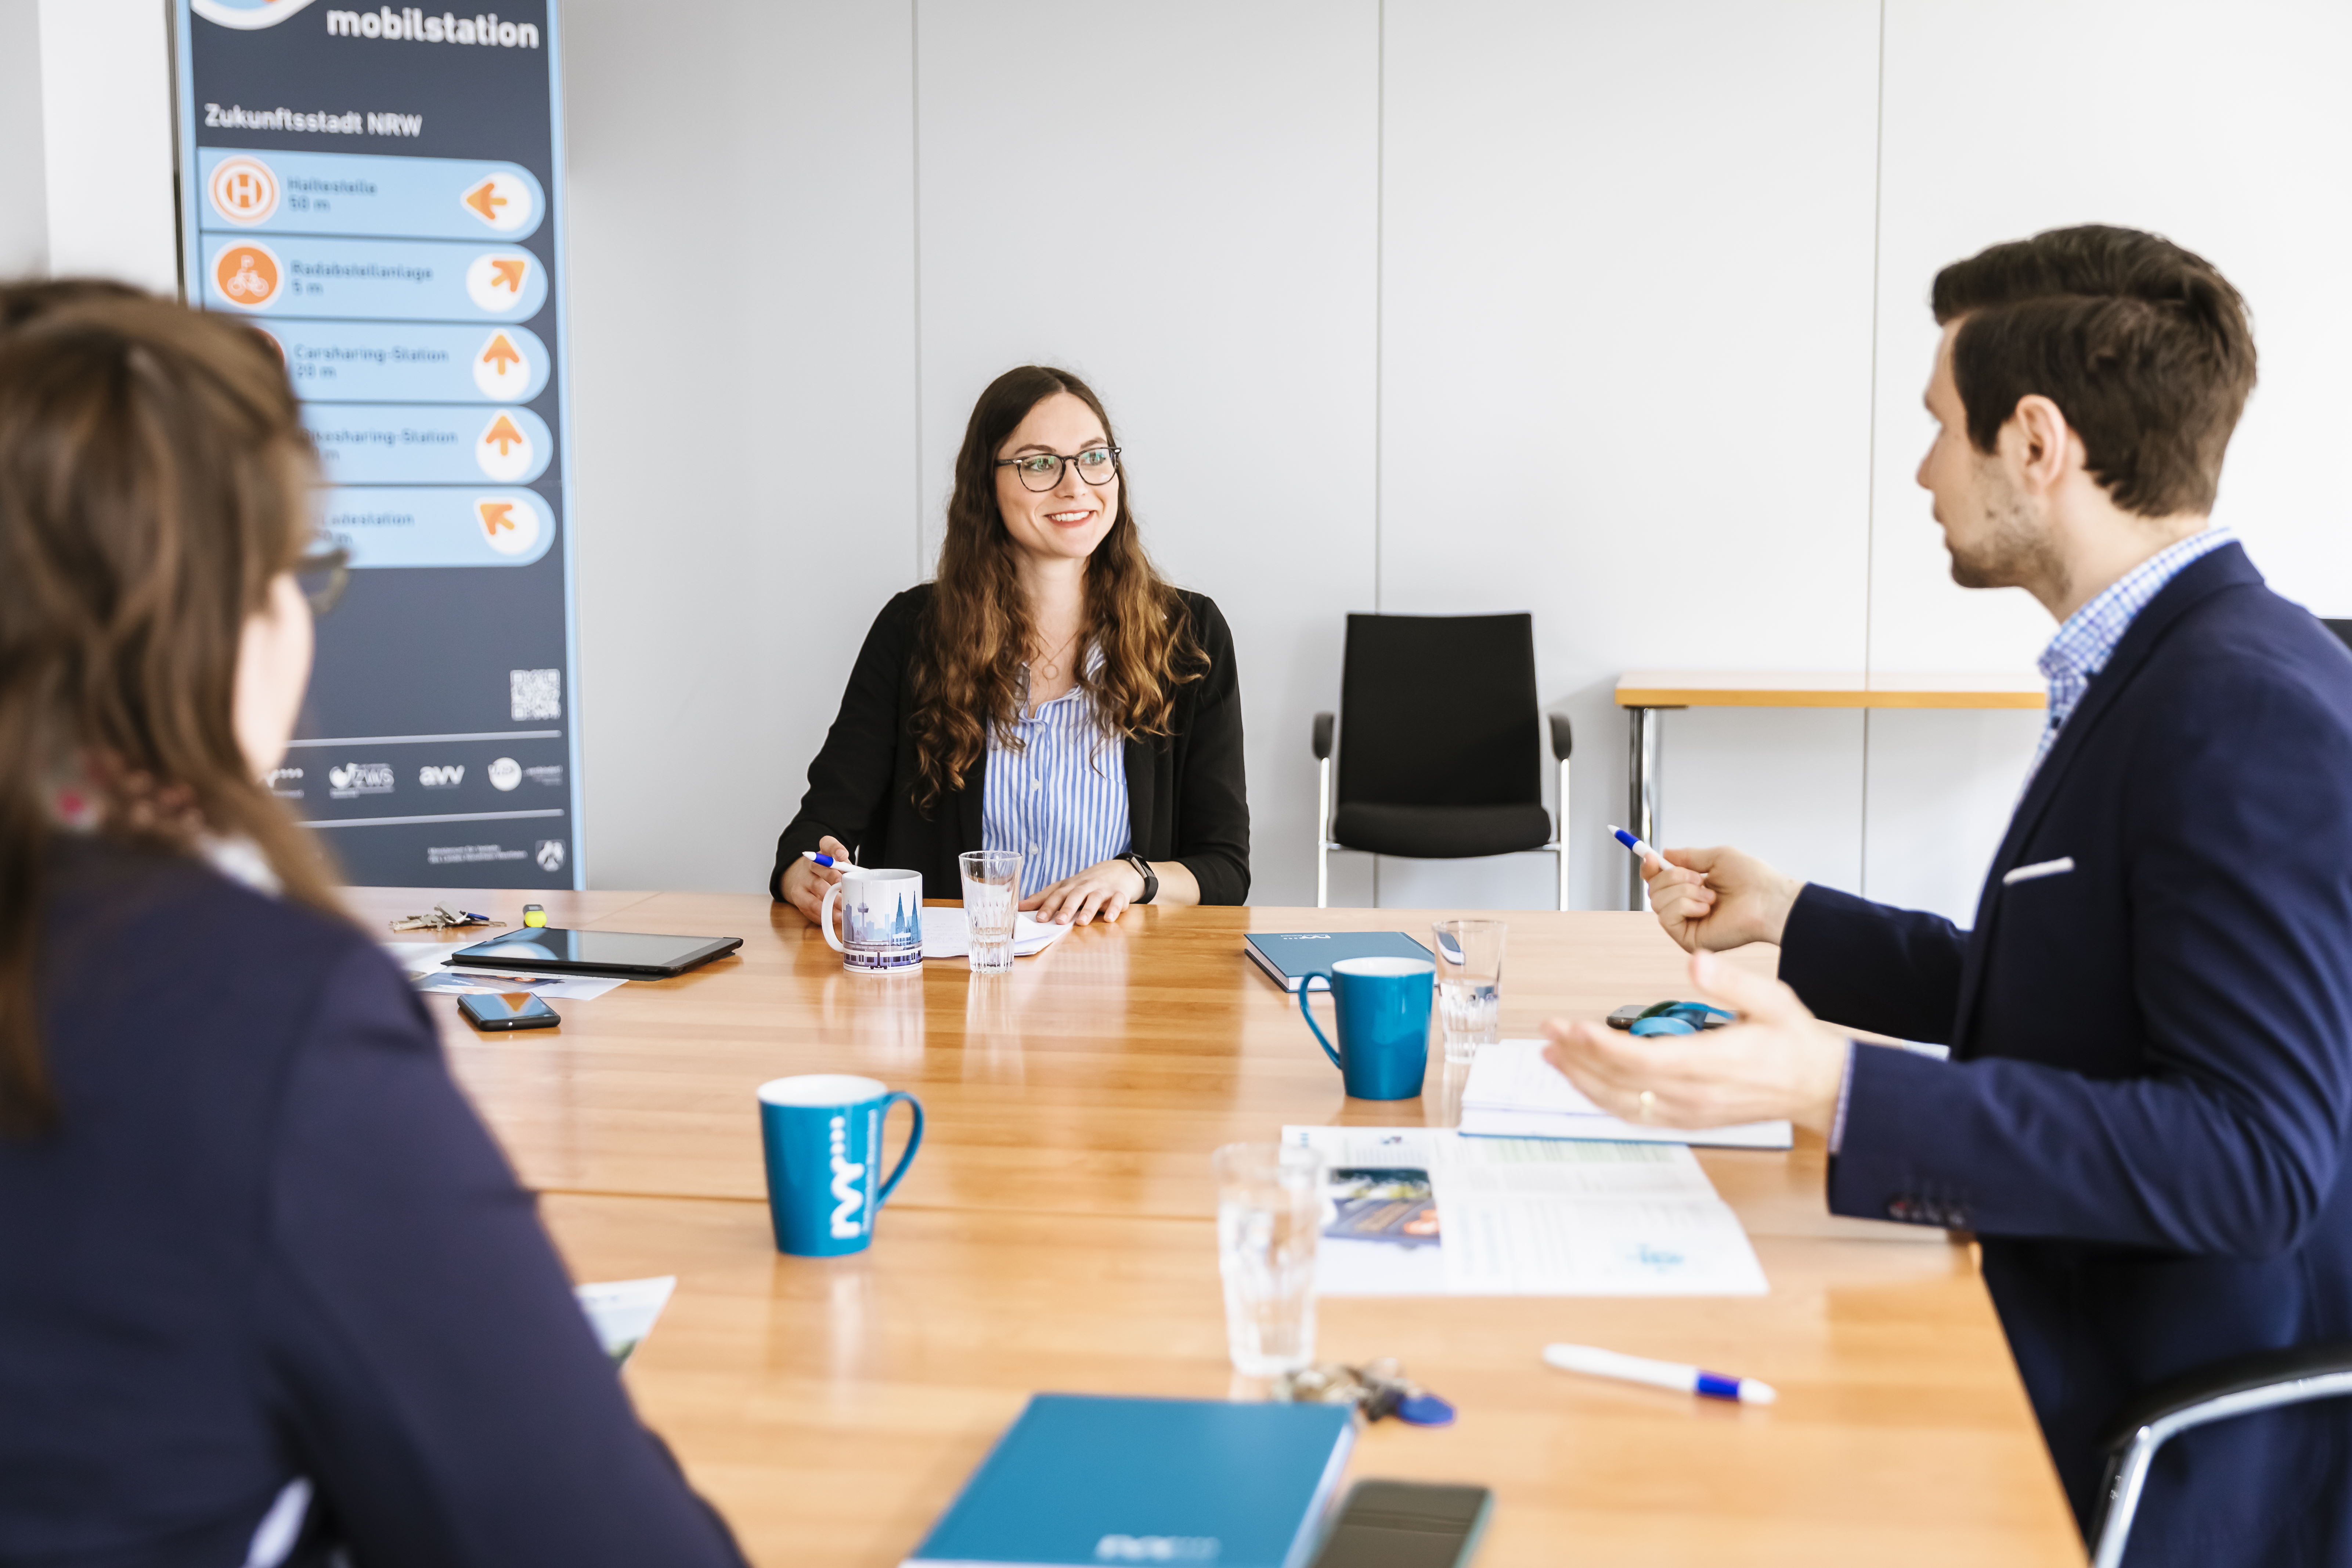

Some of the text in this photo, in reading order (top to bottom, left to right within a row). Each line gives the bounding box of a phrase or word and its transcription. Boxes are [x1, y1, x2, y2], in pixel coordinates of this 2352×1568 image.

[327, 5, 539, 49] mobilstation
[204, 103, 423, 137] Zukunftsstadt NRW
[287, 176, 378, 196] Haltestelle
[313, 198, 331, 213] m
[306, 282, 323, 296] m
[294, 344, 449, 365] Carsharing-Station
[320, 366, 336, 379] m
